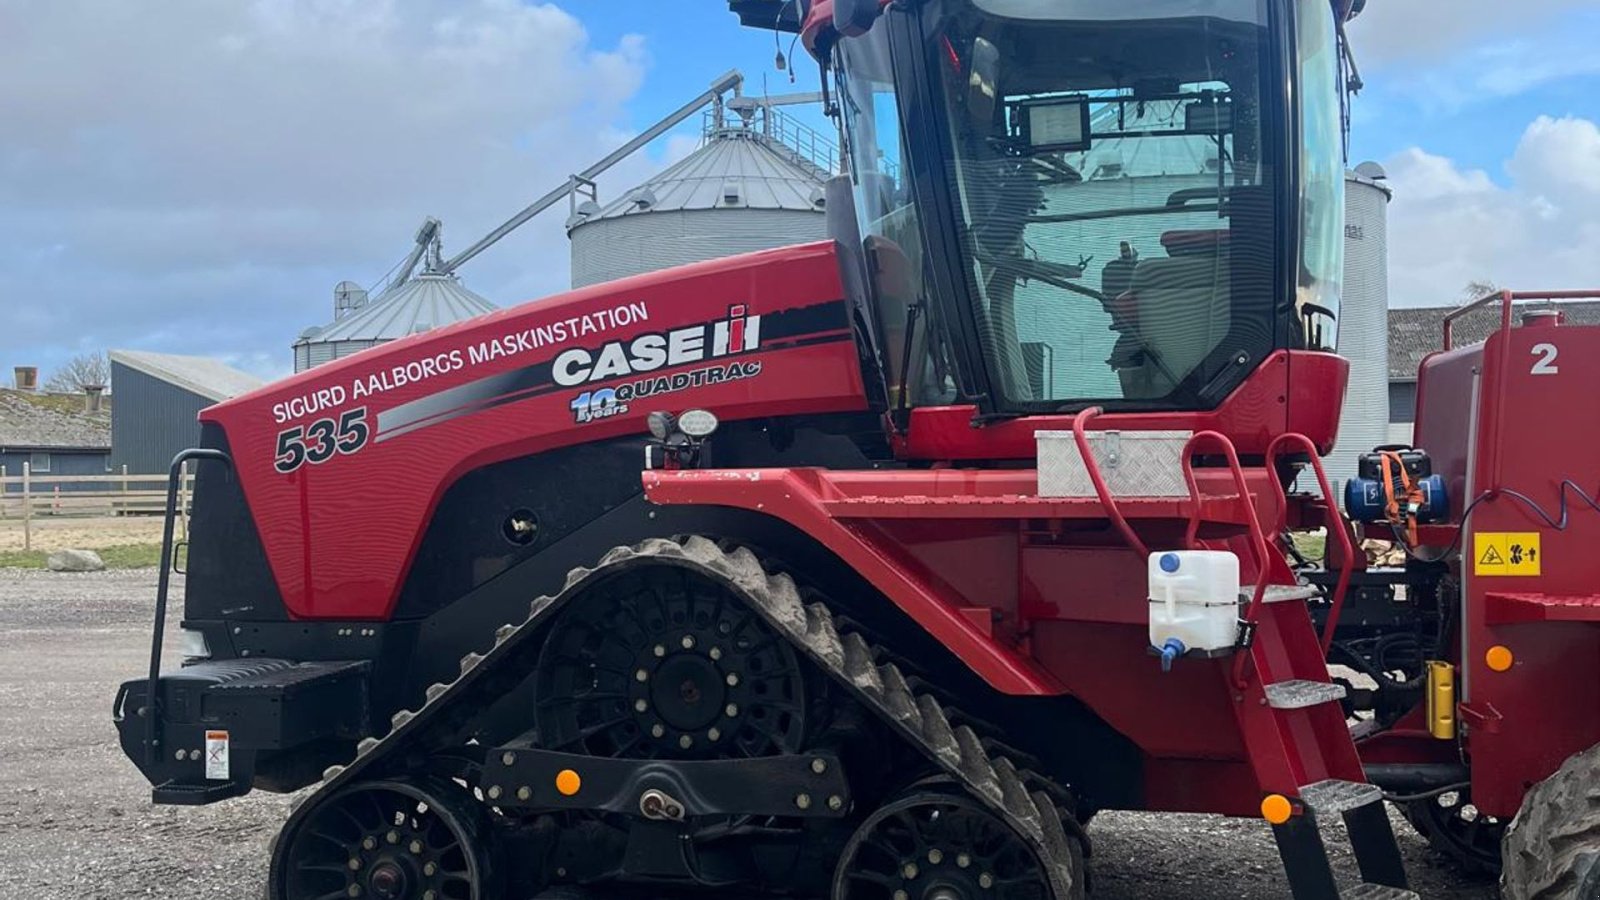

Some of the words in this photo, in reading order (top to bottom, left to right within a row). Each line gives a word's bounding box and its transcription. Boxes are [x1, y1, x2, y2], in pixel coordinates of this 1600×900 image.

[273, 386, 346, 423] SIGURD
[353, 350, 463, 399] AALBORGS
[468, 301, 648, 366] MASKINSTATION
[551, 325, 704, 386] CASE
[713, 304, 761, 357] IH
[1531, 343, 1558, 374] 2
[614, 361, 762, 402] QUADTRAC
[571, 388, 620, 421] 10
[582, 403, 629, 422] years
[274, 406, 370, 473] 535
